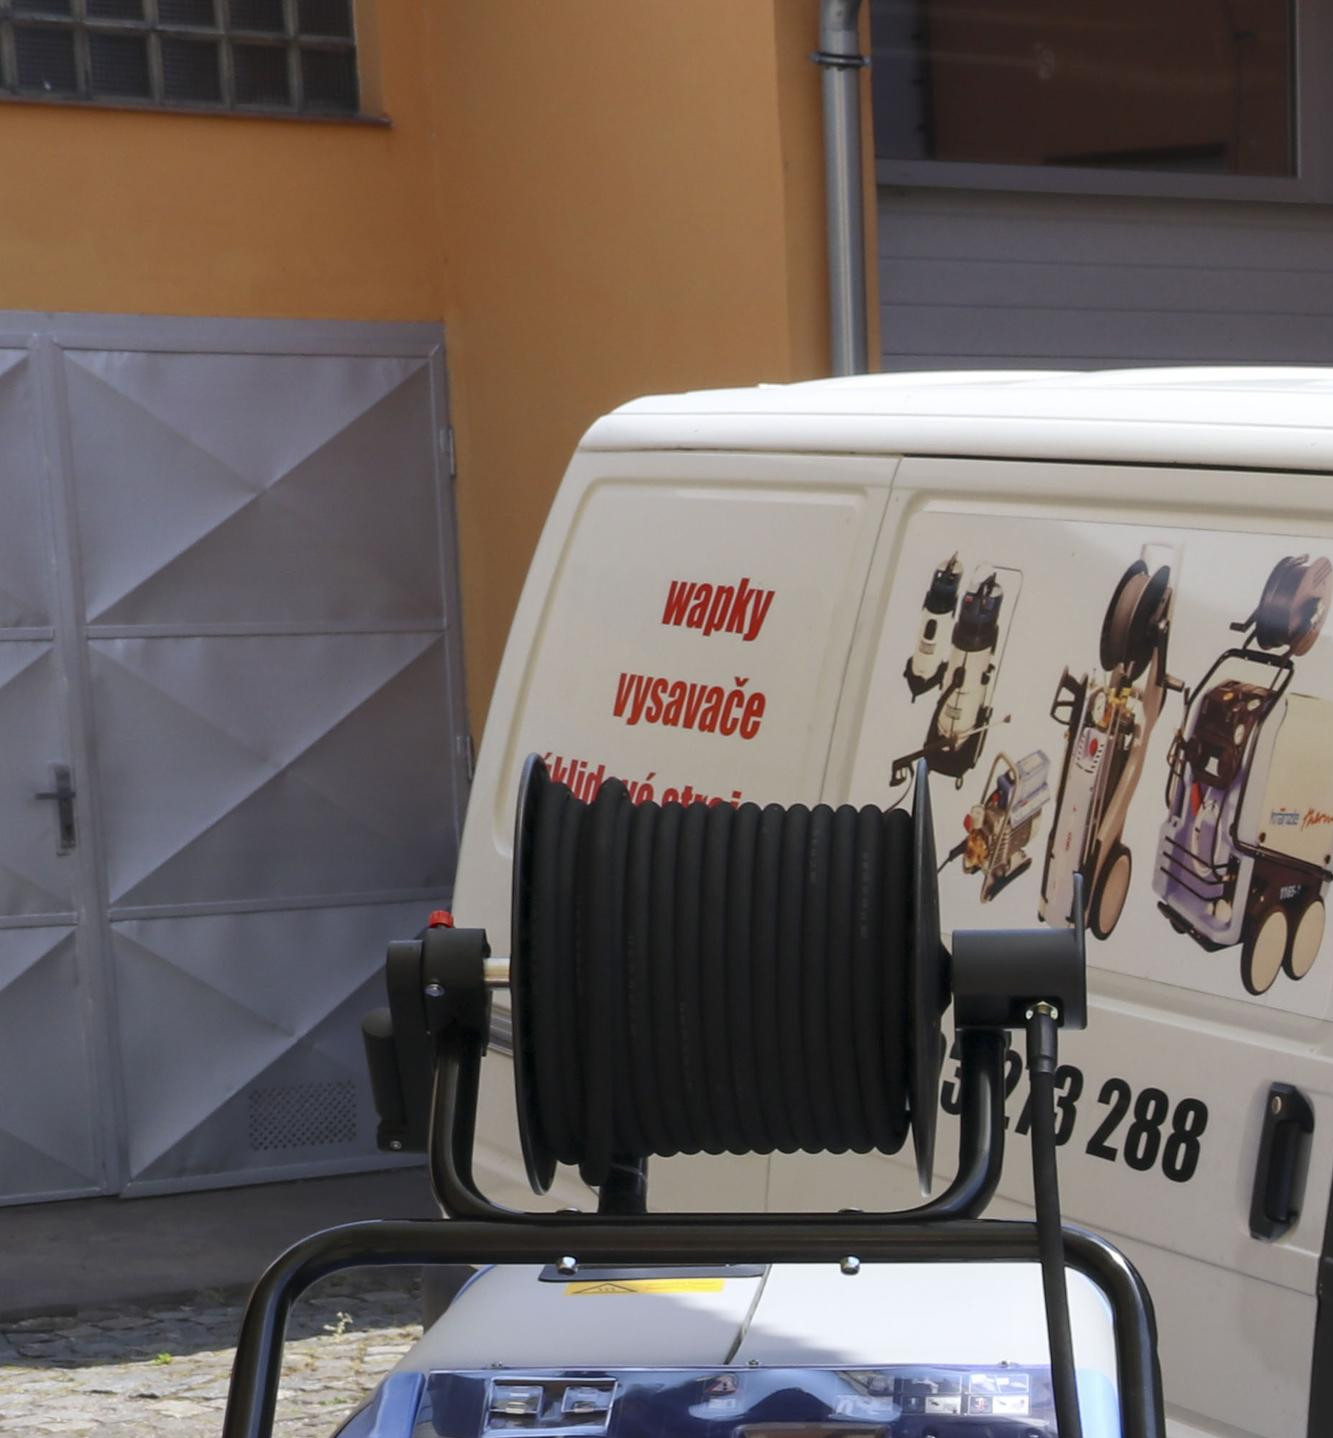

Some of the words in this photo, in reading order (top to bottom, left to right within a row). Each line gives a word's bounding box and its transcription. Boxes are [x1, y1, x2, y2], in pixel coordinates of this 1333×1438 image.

[662, 577, 776, 642] wapky
[612, 668, 768, 742] vysavače
[1086, 1077, 1209, 1184] 288
